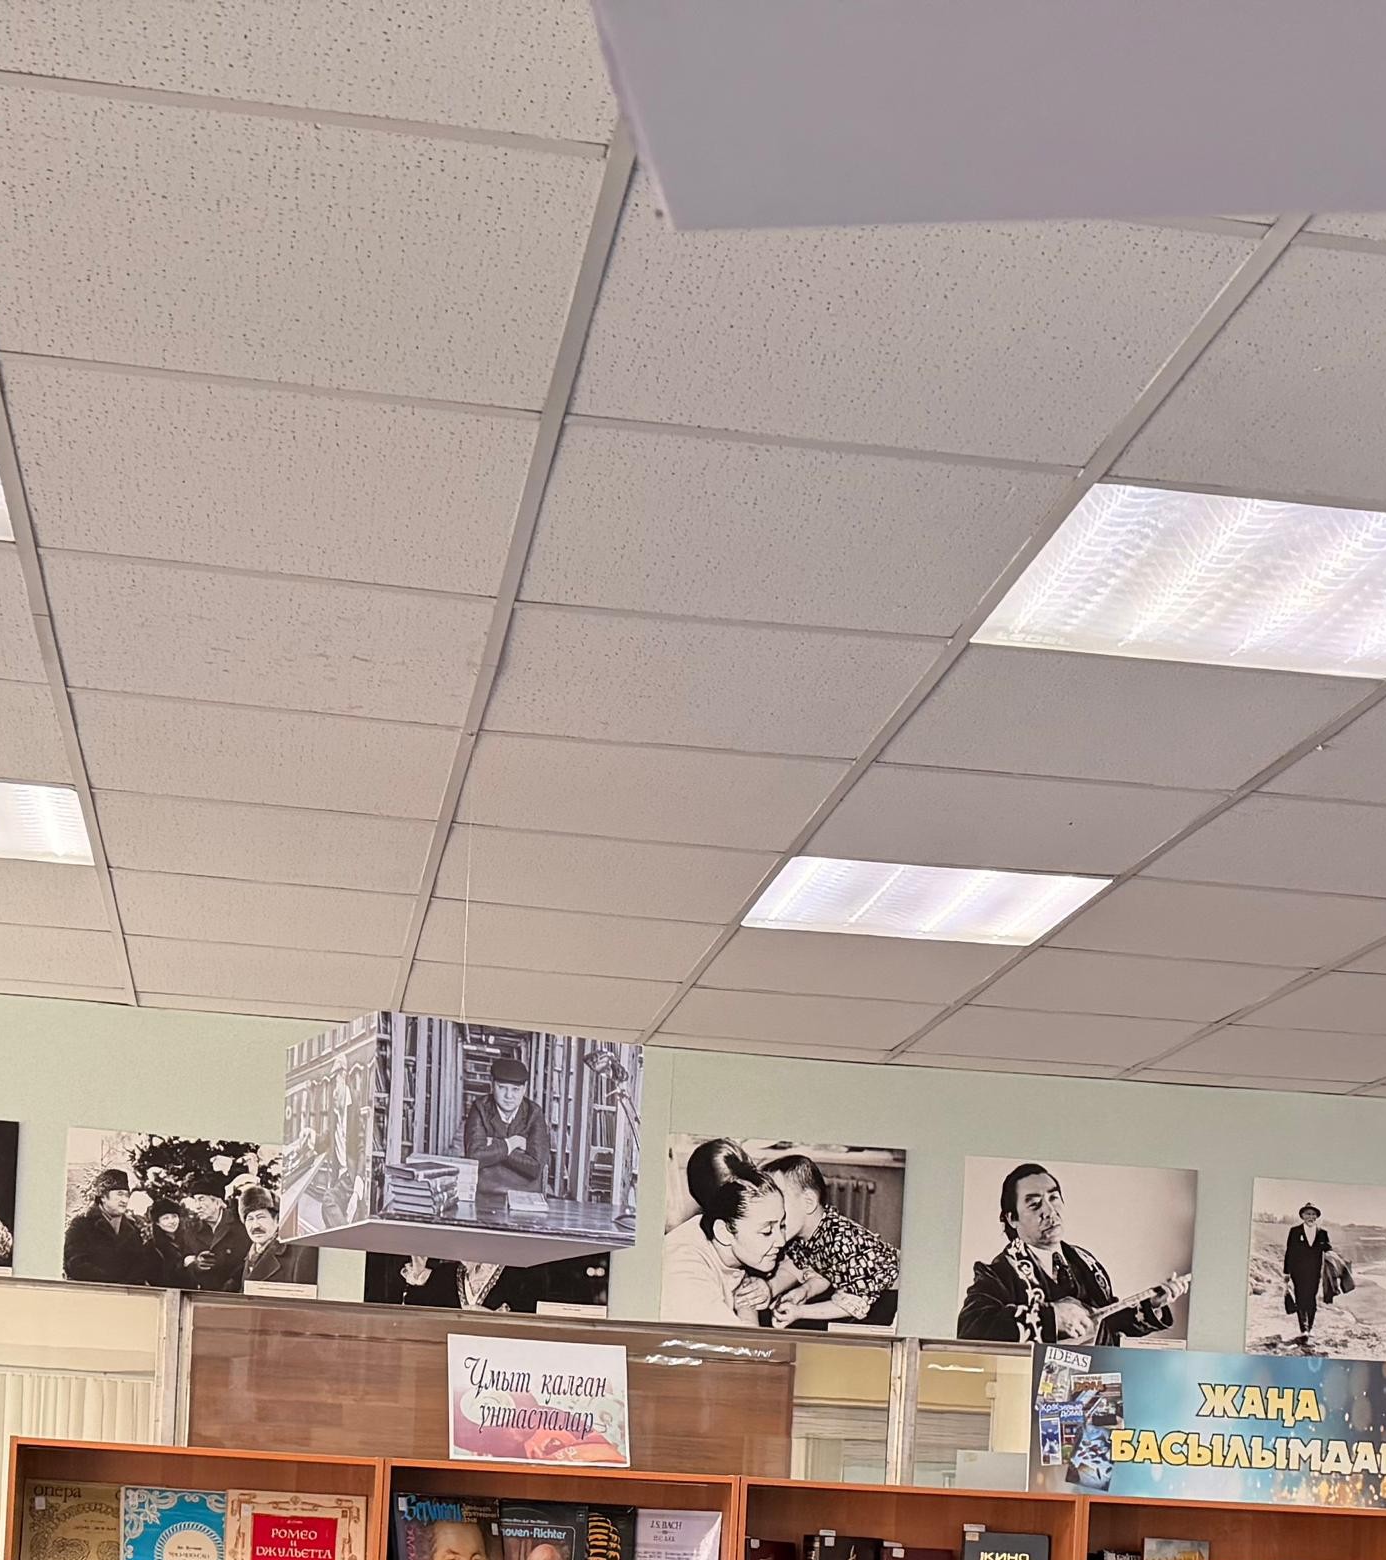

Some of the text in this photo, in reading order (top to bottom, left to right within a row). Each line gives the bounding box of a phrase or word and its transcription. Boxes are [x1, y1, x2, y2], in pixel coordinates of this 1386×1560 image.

[1048, 1350, 1089, 1368] IDEAS
[541, 1369, 607, 1405] қалған
[1196, 1382, 1322, 1428] ЖАҢА
[33, 1484, 81, 1503] опера
[271, 1528, 318, 1540] РОМЕО
[256, 1546, 332, 1560] ДЖУЛЬЕТТА
